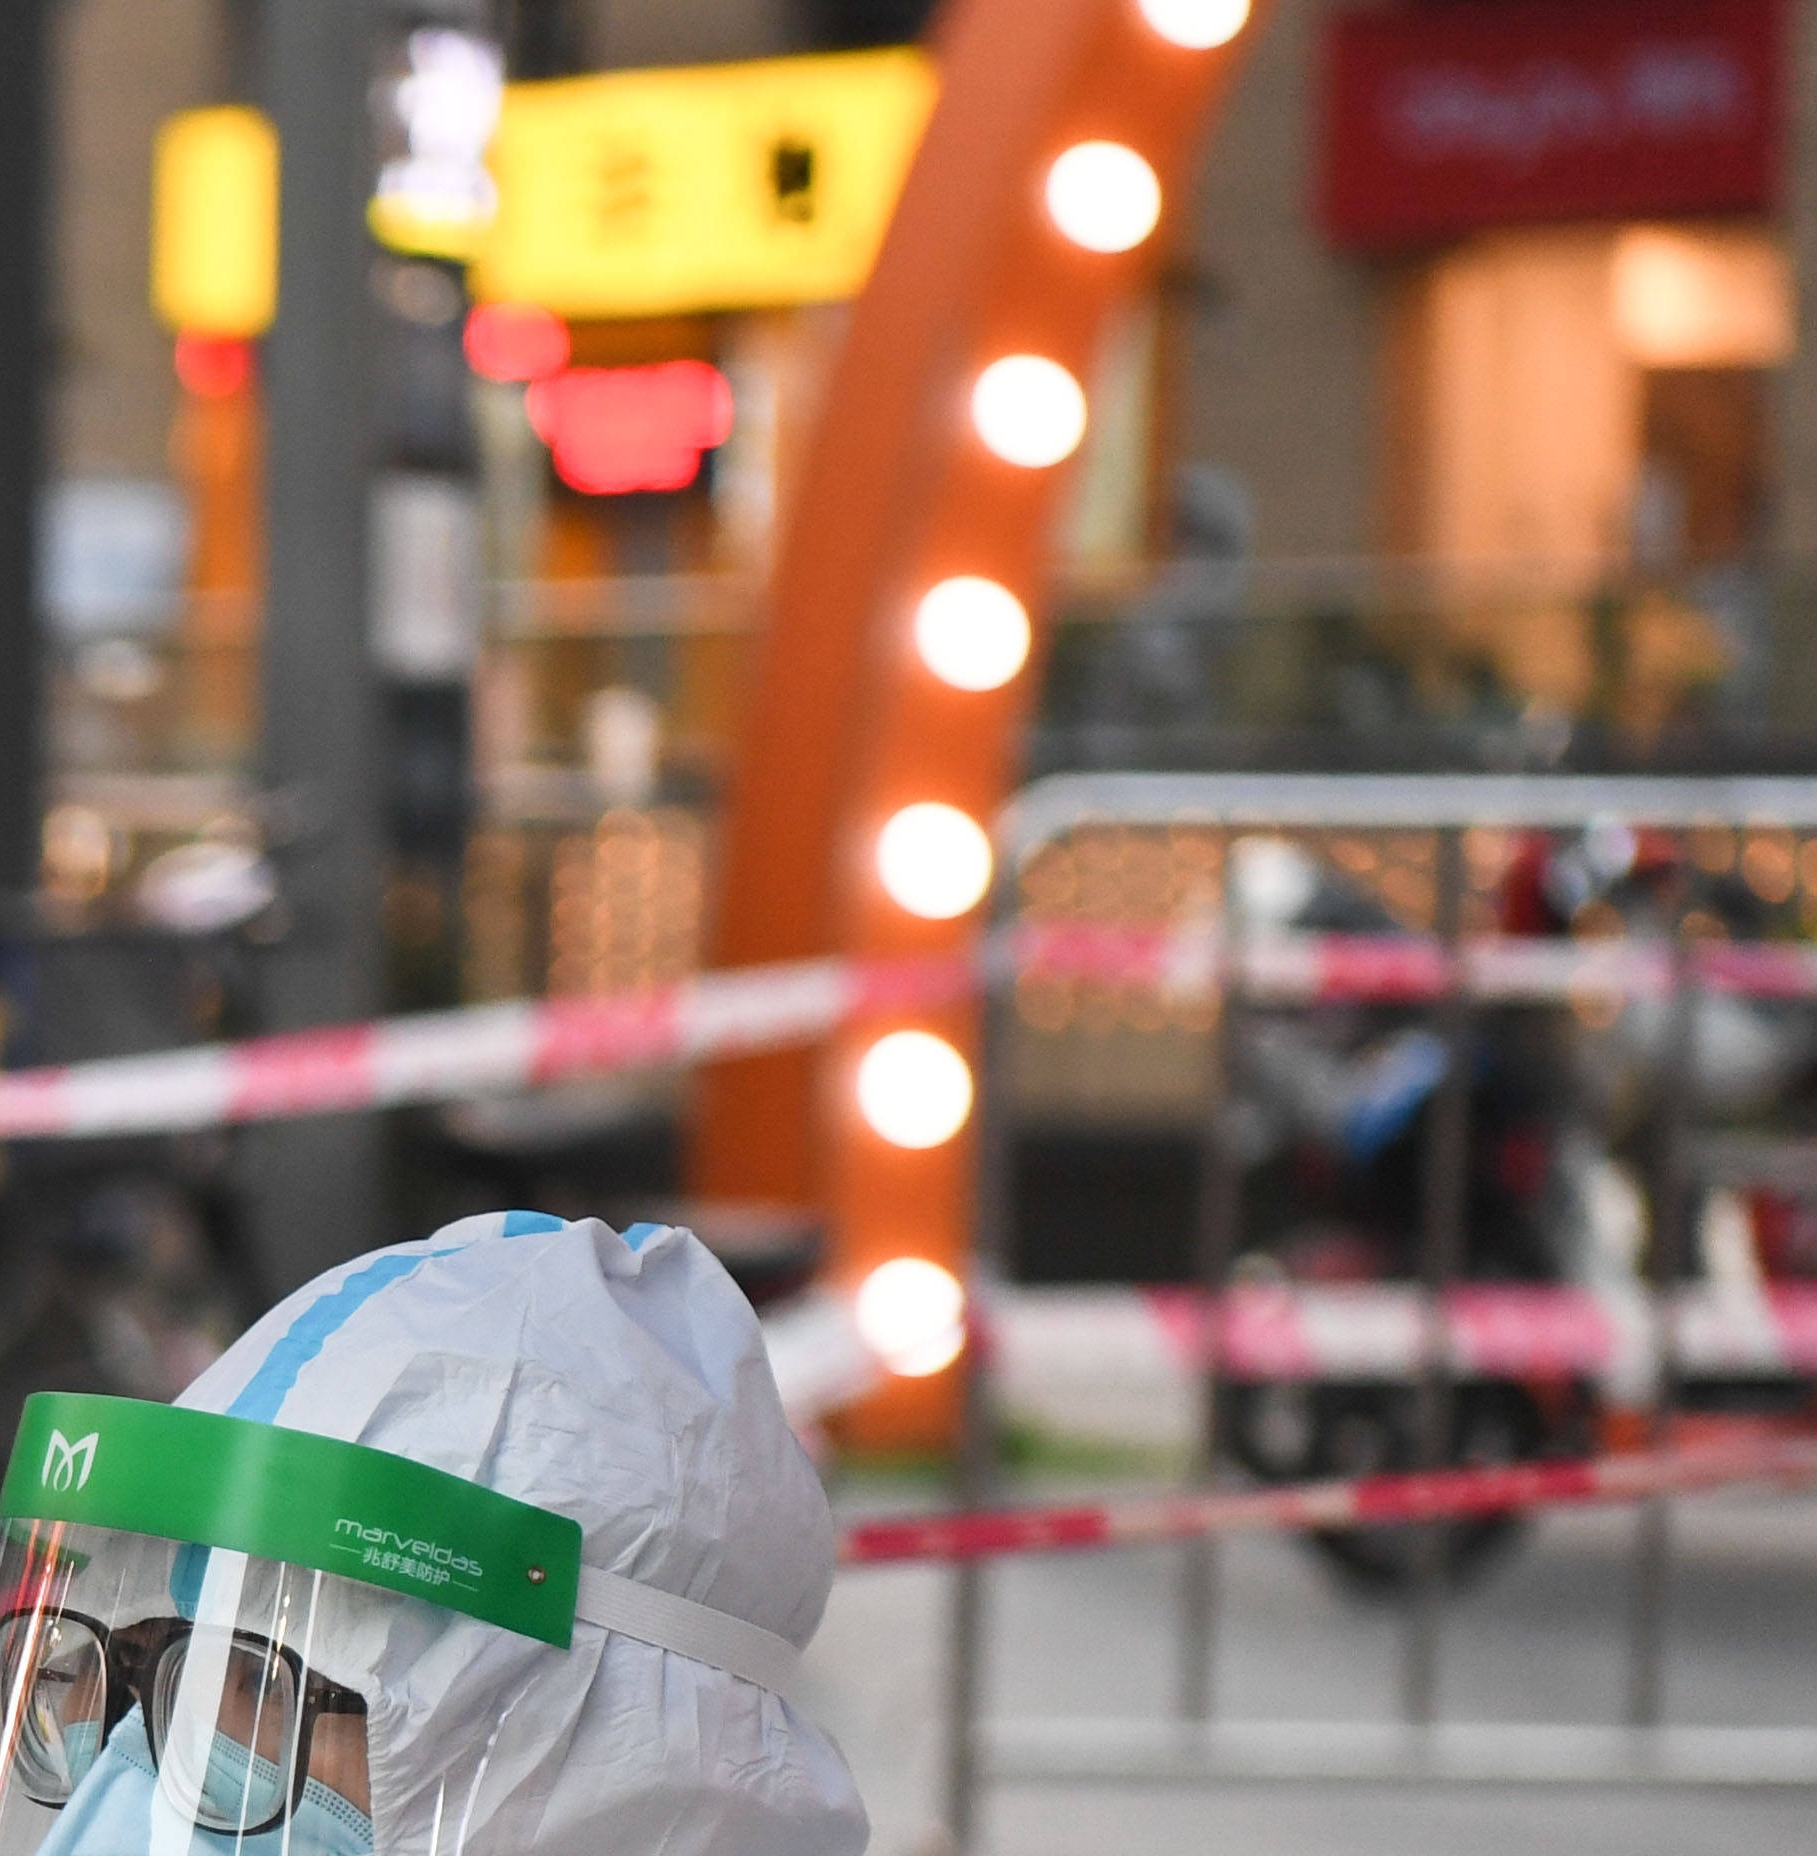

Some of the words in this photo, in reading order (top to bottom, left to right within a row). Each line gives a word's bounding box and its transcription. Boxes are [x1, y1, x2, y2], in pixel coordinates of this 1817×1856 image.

[334, 1518, 484, 1578] marveldas
[363, 1546, 451, 1587] 兆舒美防护
